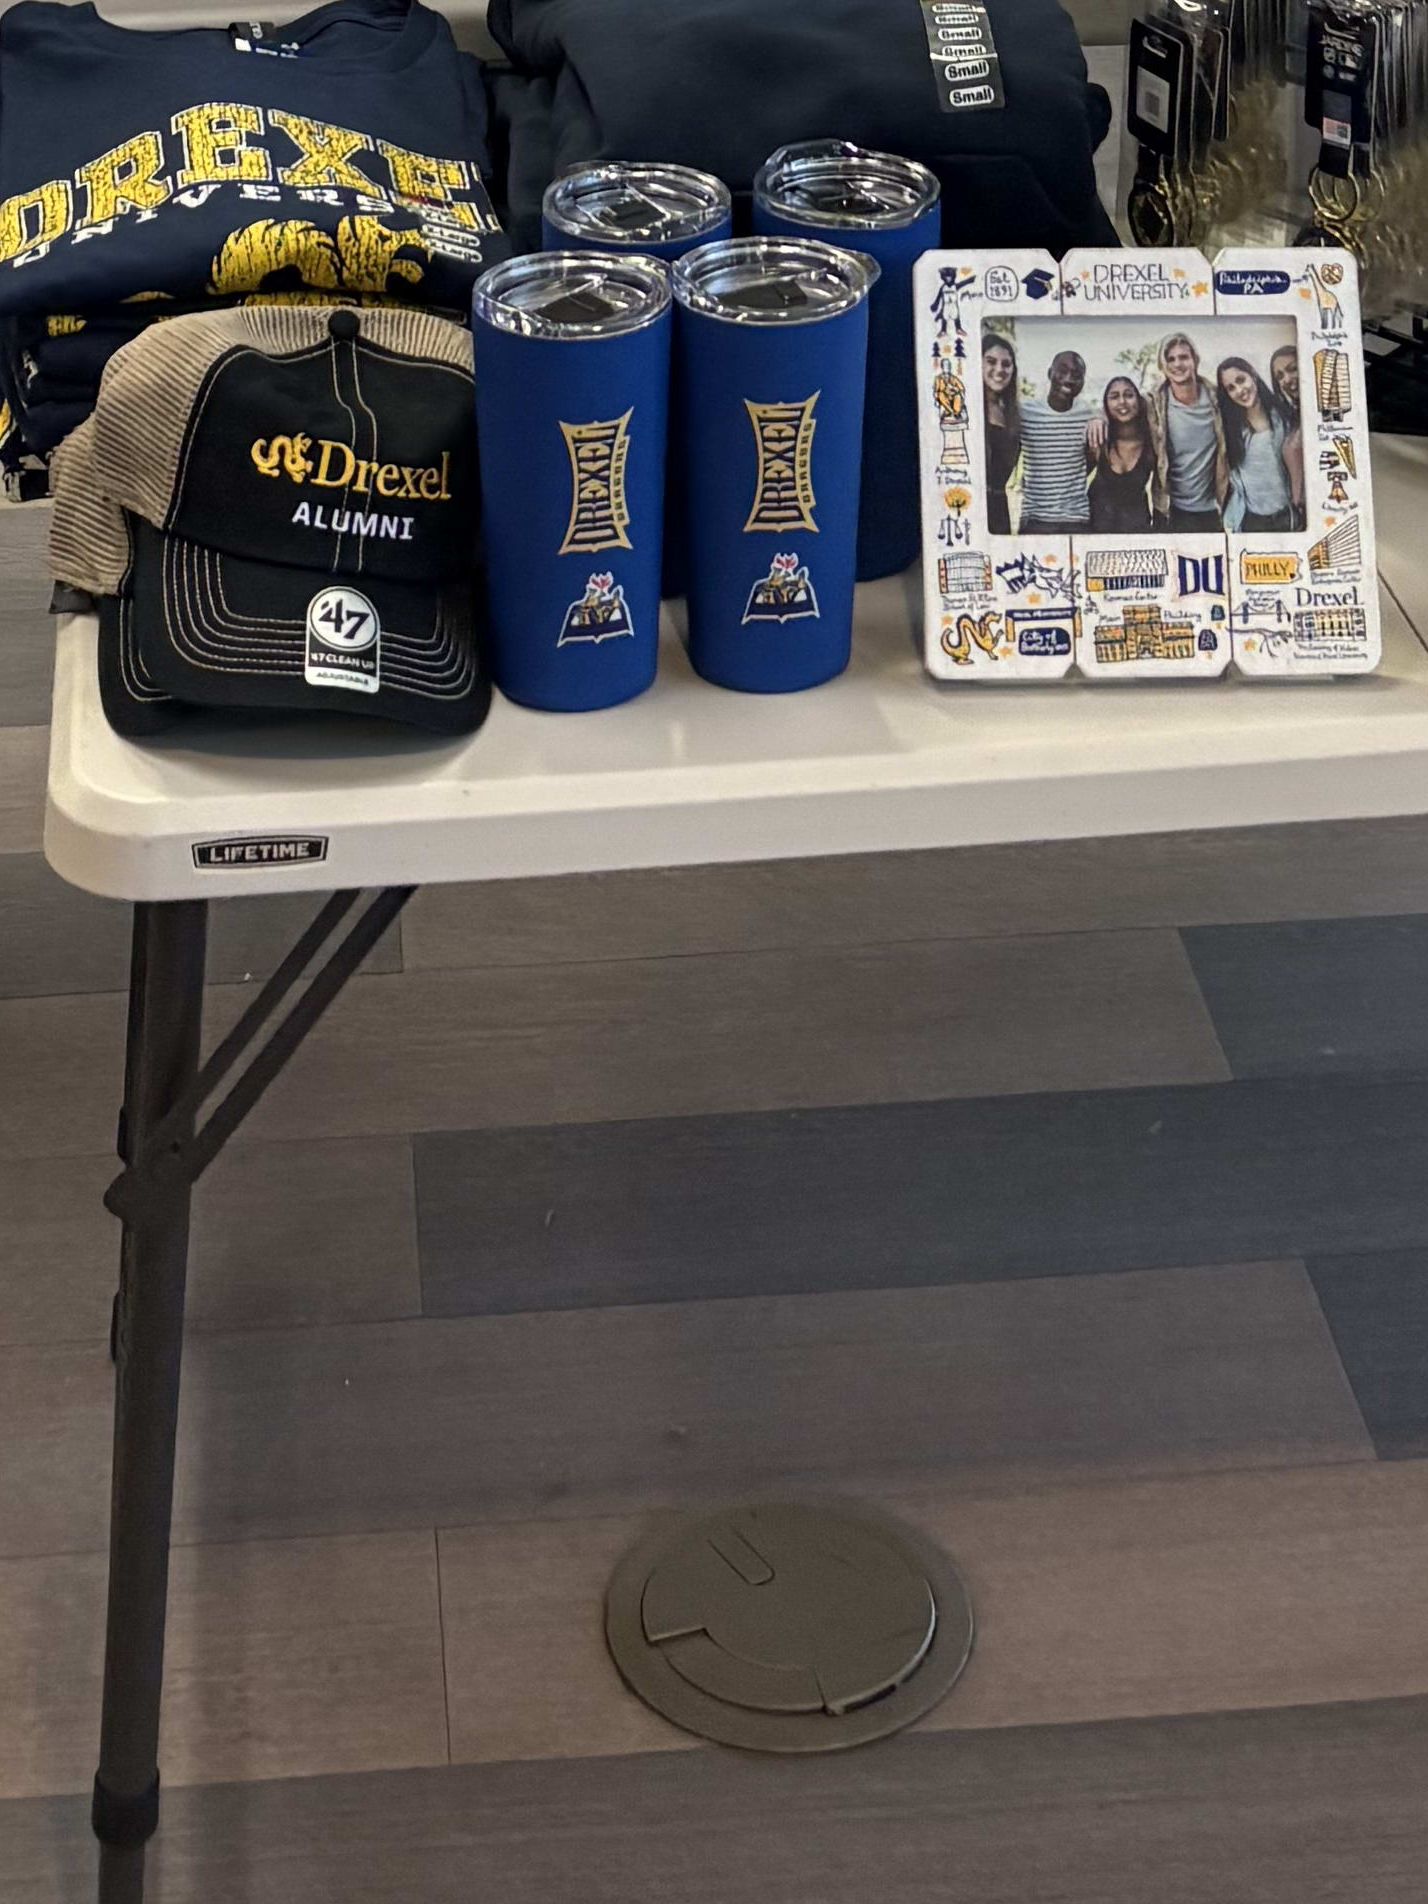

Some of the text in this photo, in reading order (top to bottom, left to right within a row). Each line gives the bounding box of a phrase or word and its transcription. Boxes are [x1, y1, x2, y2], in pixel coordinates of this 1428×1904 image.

[948, 61, 988, 80] Small
[953, 88, 993, 105] Small
[1094, 263, 1170, 284] DREXEL
[1084, 282, 1188, 302] UNIVERSITY
[1242, 284, 1263, 294] PA
[310, 439, 452, 500] Drexel
[752, 405, 808, 525] DREXEL
[566, 426, 621, 547] DREXEL
[291, 501, 415, 541] ALUMNI
[1177, 554, 1225, 597] DU
[1244, 560, 1291, 577] PHILLY
[1294, 586, 1366, 607] Drexel
[318, 597, 371, 640] '47
[325, 652, 361, 668] CLEAN
[208, 840, 311, 864] LIFETIME
